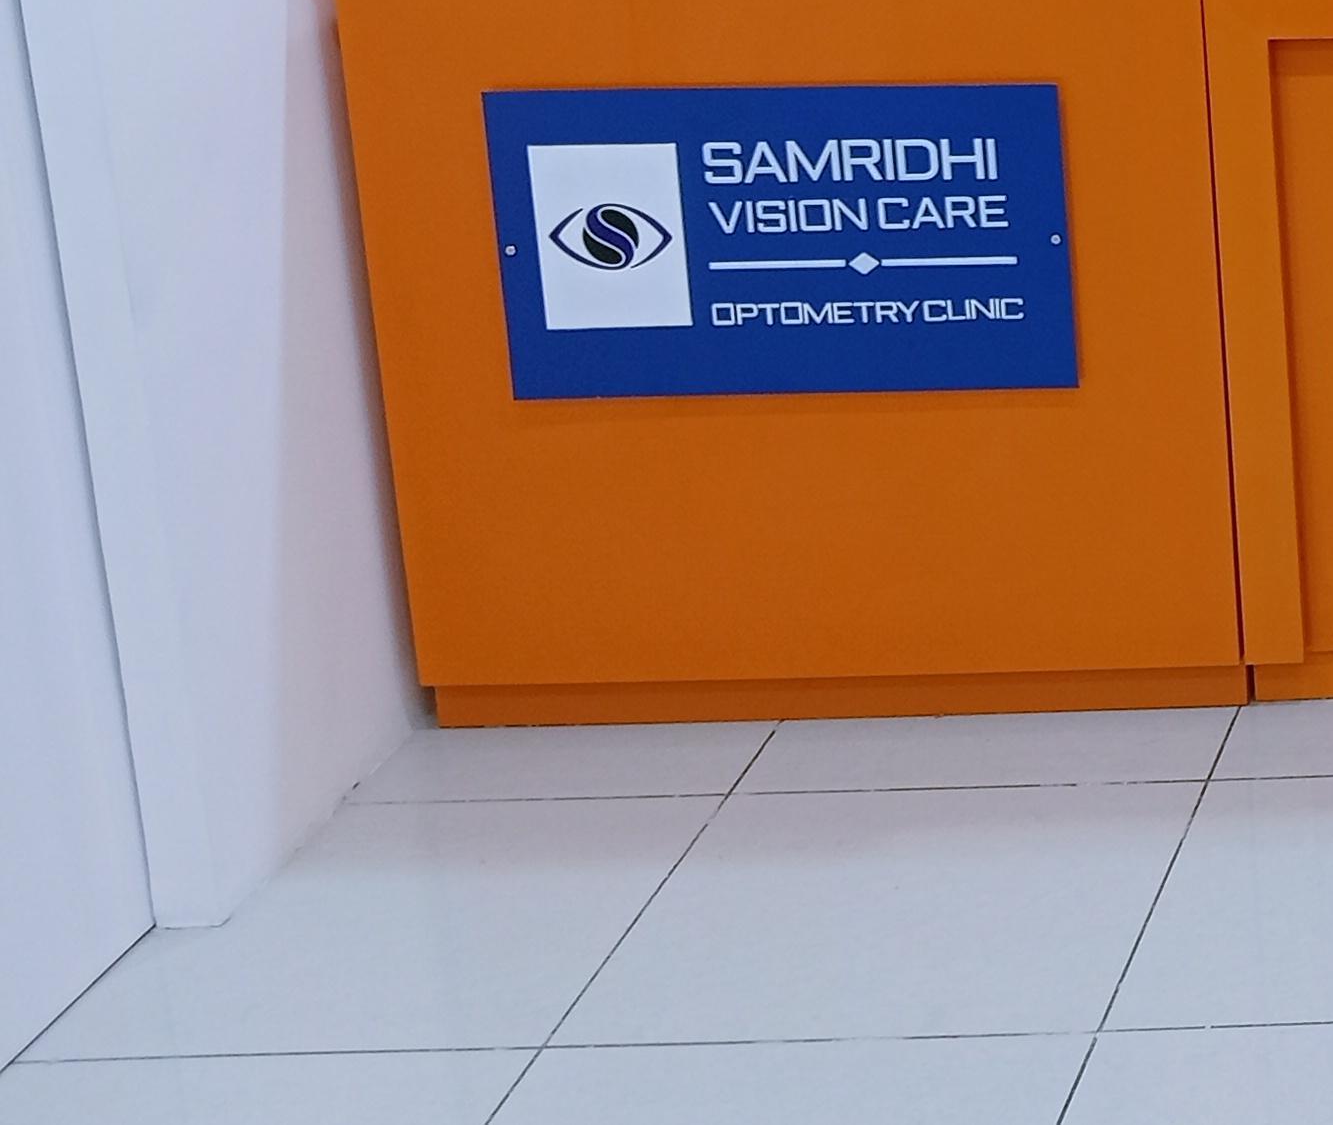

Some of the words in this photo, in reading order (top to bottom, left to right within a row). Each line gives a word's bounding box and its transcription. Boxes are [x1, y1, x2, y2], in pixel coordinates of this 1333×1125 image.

[702, 138, 998, 184] SAMRIDHI
[708, 198, 868, 234] VISION
[877, 195, 1009, 230] CARE
[711, 300, 919, 326] OPTOMETRY
[923, 298, 1024, 321] CLINIC
